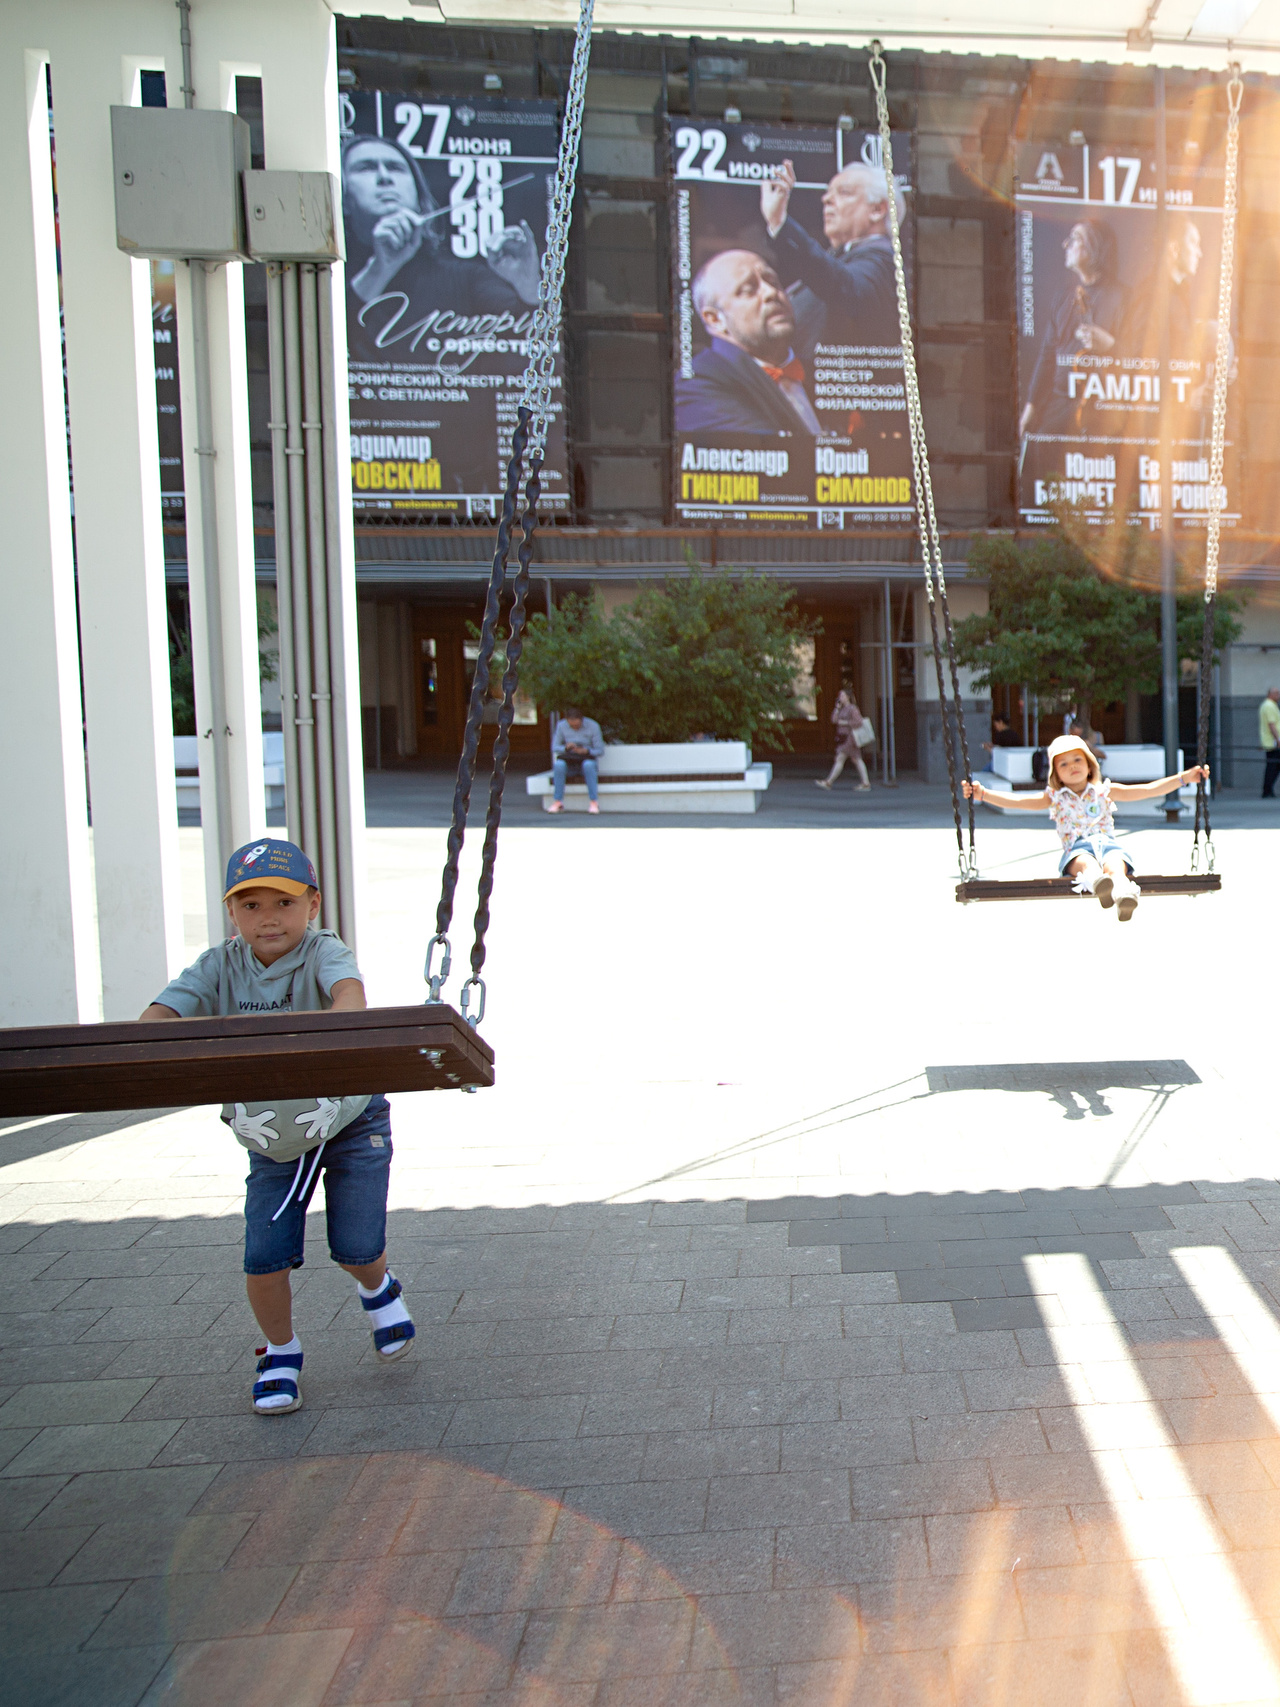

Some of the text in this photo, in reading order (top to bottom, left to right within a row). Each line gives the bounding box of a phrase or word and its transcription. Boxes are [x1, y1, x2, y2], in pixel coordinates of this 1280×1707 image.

[394, 101, 450, 157] 27
[675, 127, 727, 179] 22
[449, 157, 503, 208] 28
[1098, 156, 1141, 205] 17
[1020, 210, 1034, 273] ПРЕМЬЕРА
[1021, 286, 1035, 336] МОСКВЕ
[357, 291, 560, 376] Истори
[680, 289, 694, 379] ЧАЙКОВСКИЙ
[814, 369, 874, 382] ОРКЕСТР
[1056, 354, 1114, 368] ШЕКСПИР
[378, 388, 469, 402] СВЕТЛАНОВА
[442, 375, 504, 388] ОРКЕСТР
[814, 383, 905, 397] МОСКОВСКОЙ
[814, 398, 906, 411] ФИЛАРМОНИИ
[681, 443, 789, 477] Александр
[815, 447, 869, 478] Юрий
[1065, 452, 1116, 482] Юрий
[682, 472, 759, 504] ГИНДИН
[816, 476, 911, 503] СИМОНОВ
